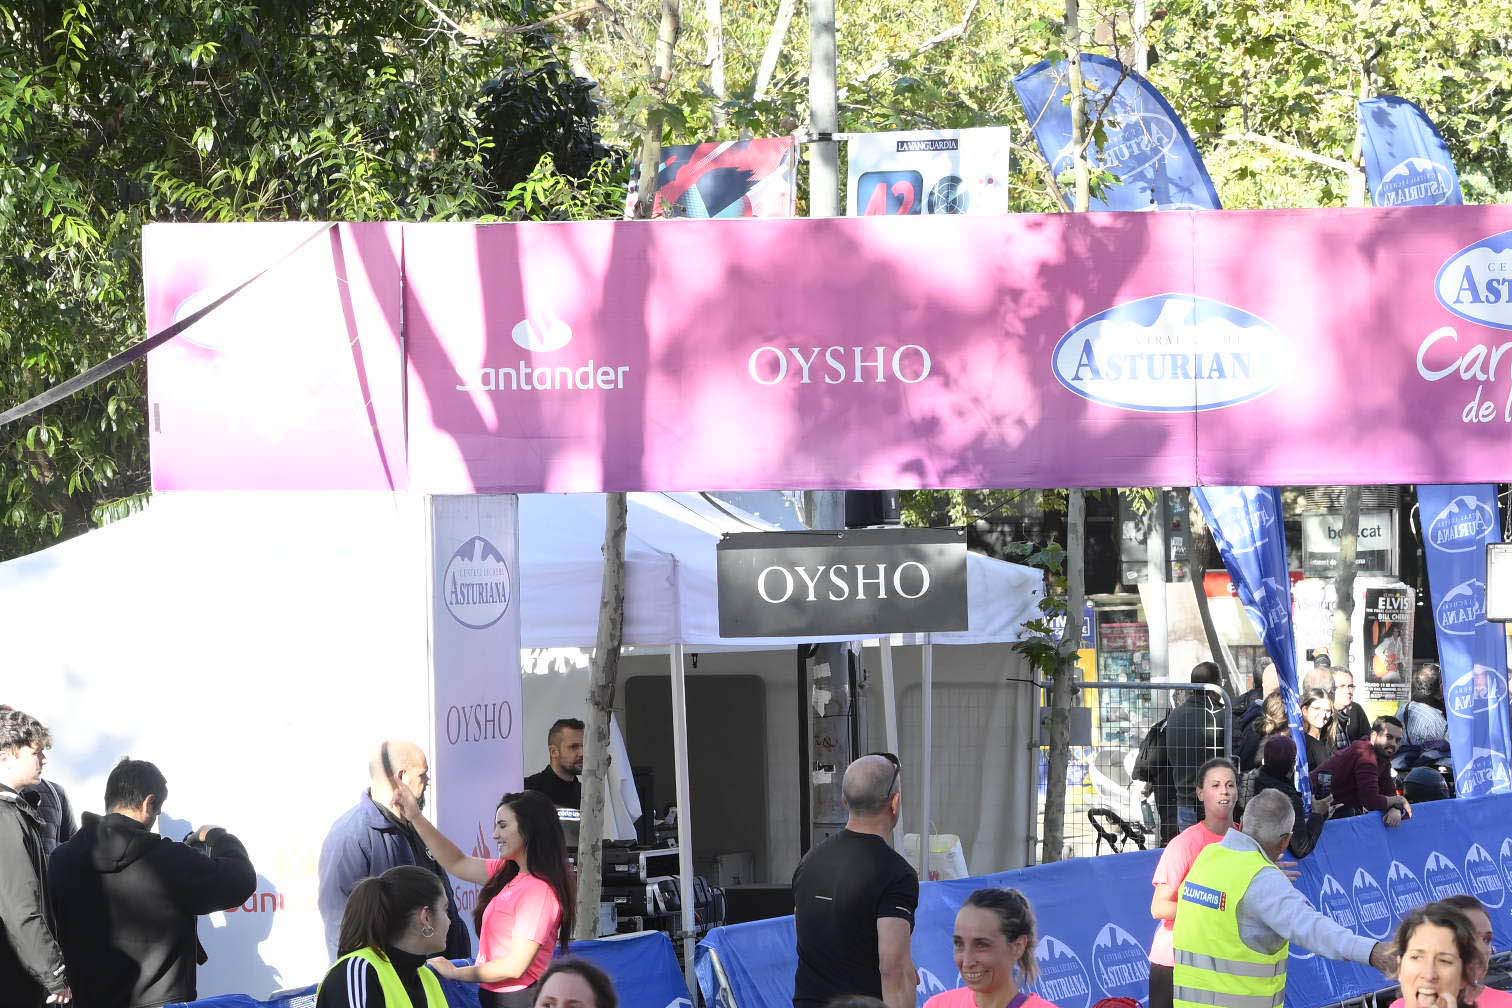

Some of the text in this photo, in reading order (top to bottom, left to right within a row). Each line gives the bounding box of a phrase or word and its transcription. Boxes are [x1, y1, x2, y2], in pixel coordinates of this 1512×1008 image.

[747, 343, 932, 386] OYSHO
[1071, 338, 1254, 381] ASTURIAN
[1462, 384, 1497, 424] de
[449, 571, 507, 606] ASTURIANA
[757, 561, 931, 604] OYSHO
[1378, 597, 1410, 611] ELVIS
[446, 699, 513, 745] OYSHO
[1184, 886, 1220, 905] OLUNTARIS
